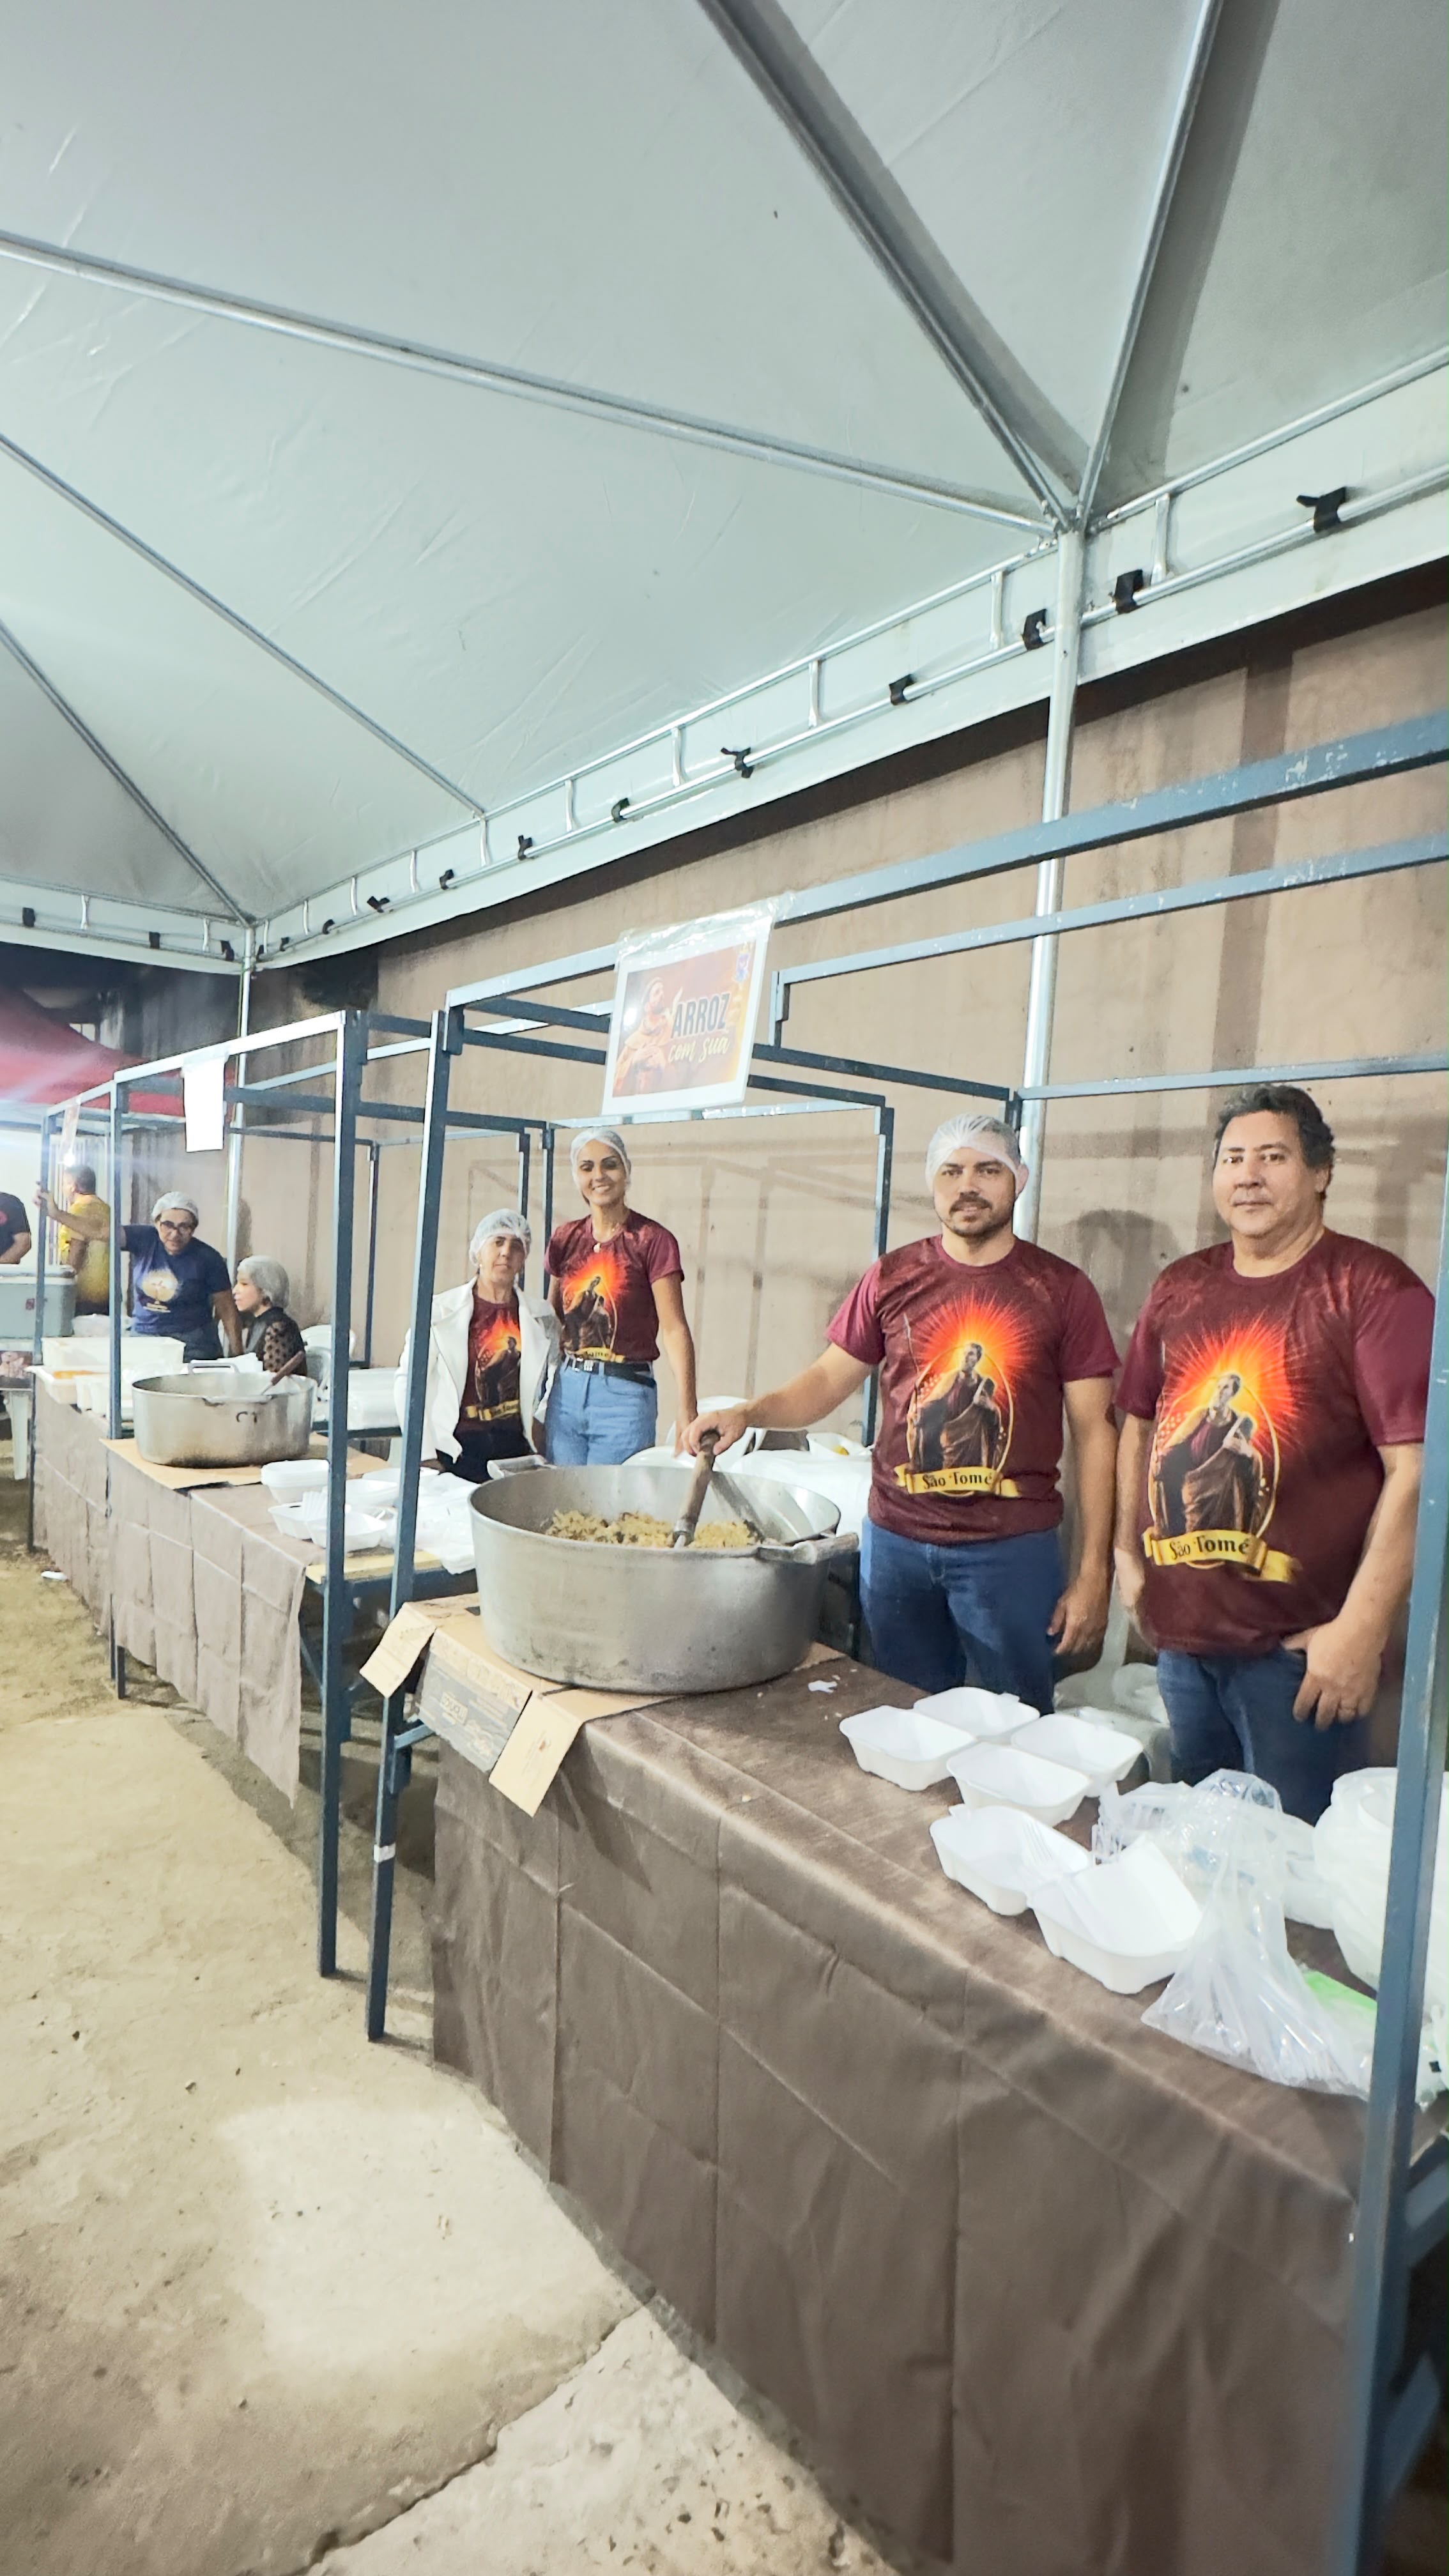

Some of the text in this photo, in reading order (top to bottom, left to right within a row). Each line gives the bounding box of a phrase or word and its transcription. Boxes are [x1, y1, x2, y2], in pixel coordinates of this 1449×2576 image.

[670, 992, 730, 1039] ARROZ
[668, 1041, 696, 1063] com
[922, 1474, 946, 1490] São
[1170, 1535, 1250, 1560] São Tomé
